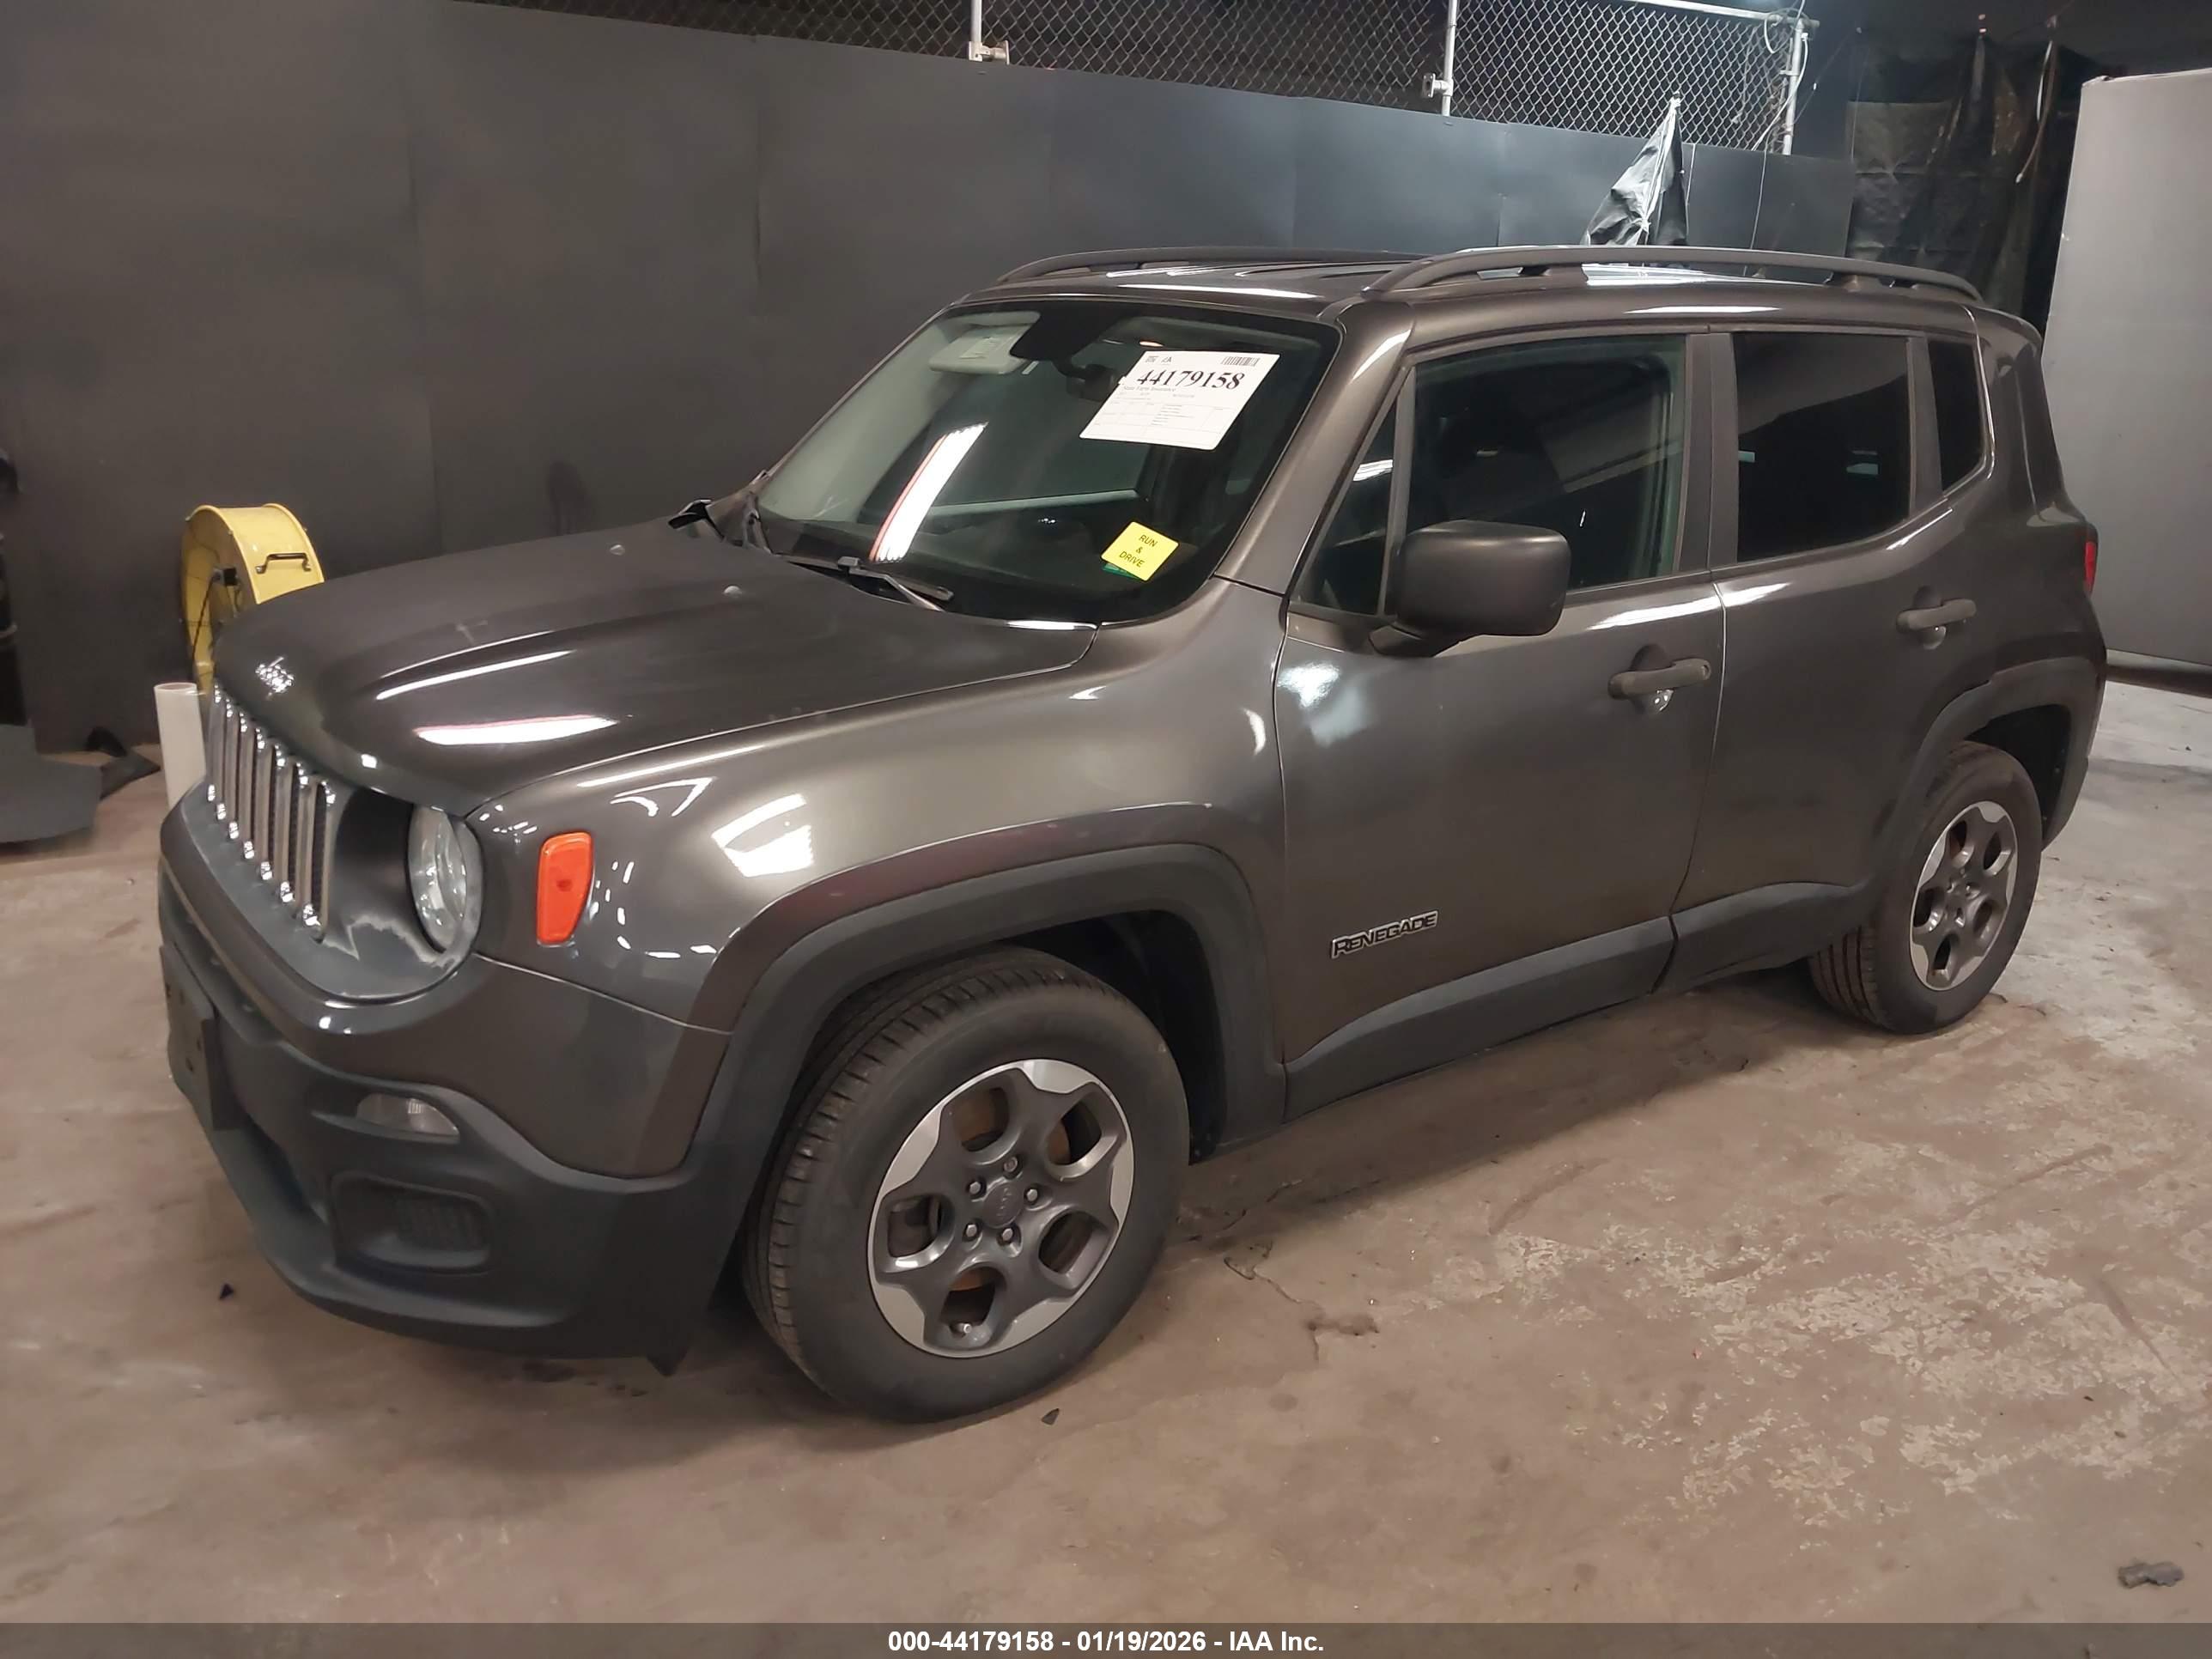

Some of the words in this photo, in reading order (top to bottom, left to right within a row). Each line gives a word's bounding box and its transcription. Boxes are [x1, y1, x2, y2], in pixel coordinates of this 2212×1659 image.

[1136, 369, 1246, 390] 44179158
[1139, 534, 1158, 547] RUN
[1119, 550, 1146, 568] DRIVE
[1331, 910, 1438, 959] RENEGADE
